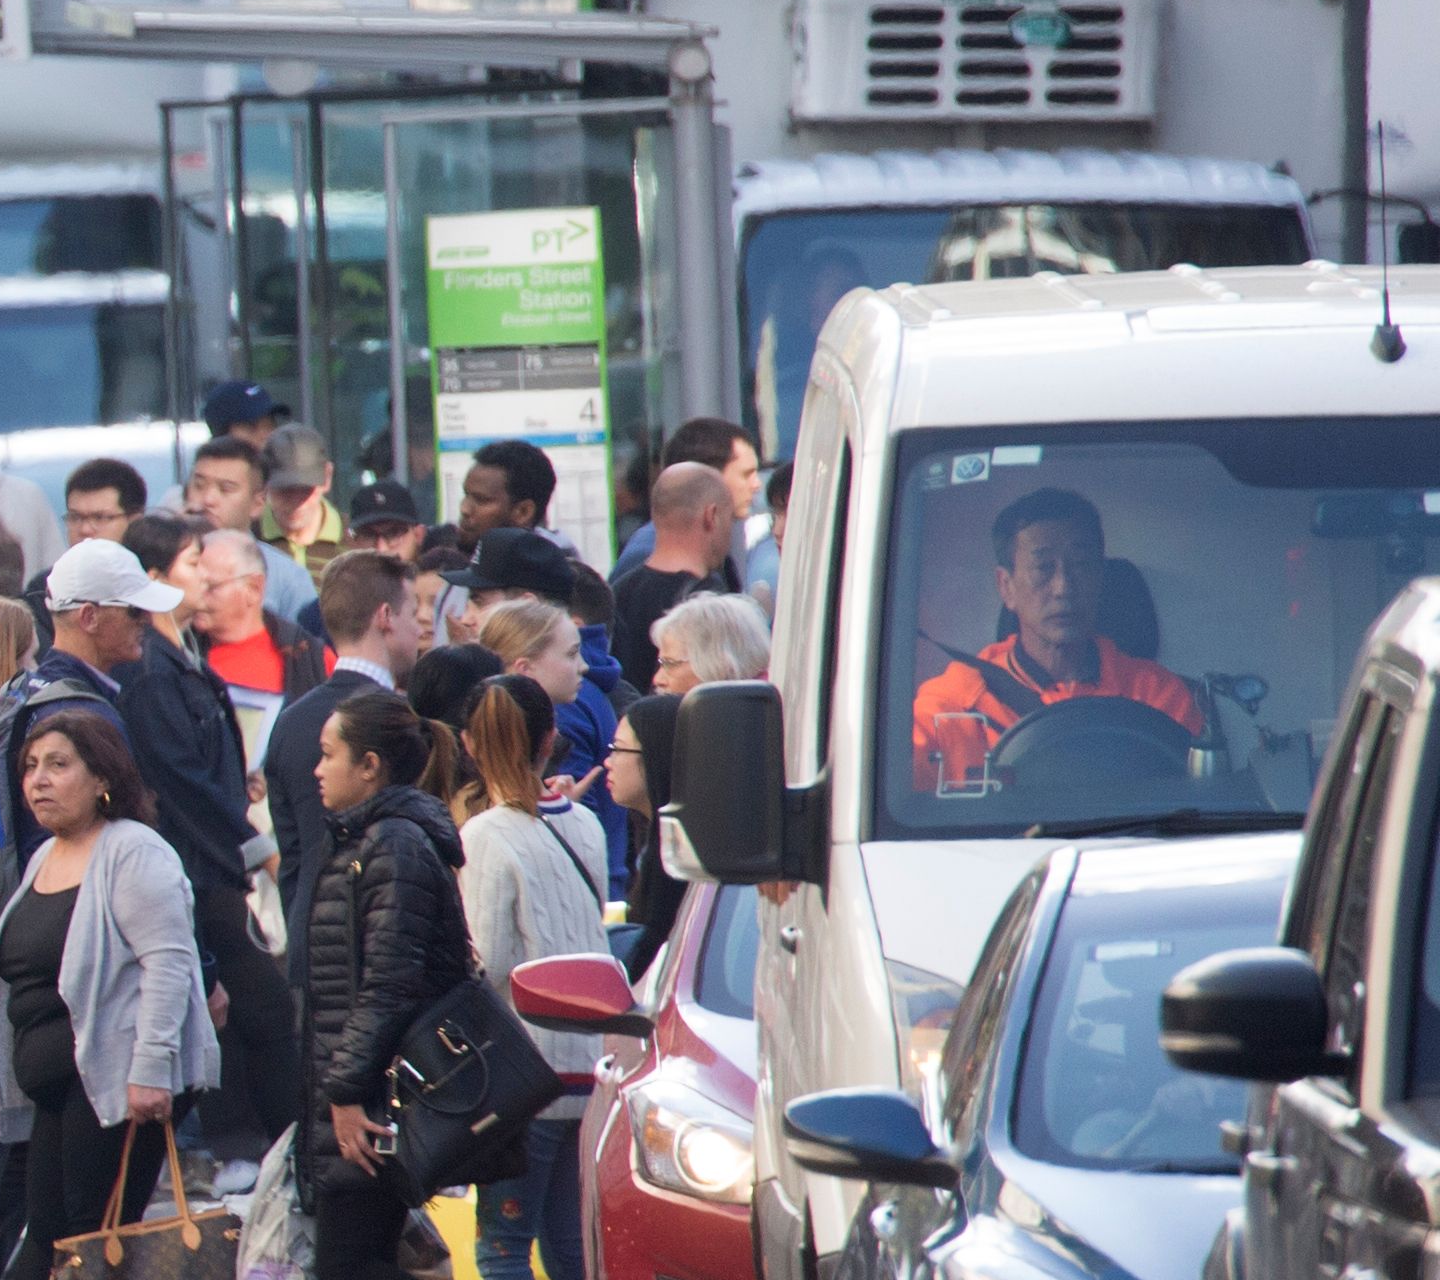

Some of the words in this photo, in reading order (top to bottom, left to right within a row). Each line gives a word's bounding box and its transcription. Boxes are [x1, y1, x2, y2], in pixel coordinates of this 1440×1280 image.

[443, 269, 524, 290] Flinders
[528, 265, 592, 286] Street
[519, 288, 592, 311] Station
[579, 397, 598, 426] 4
